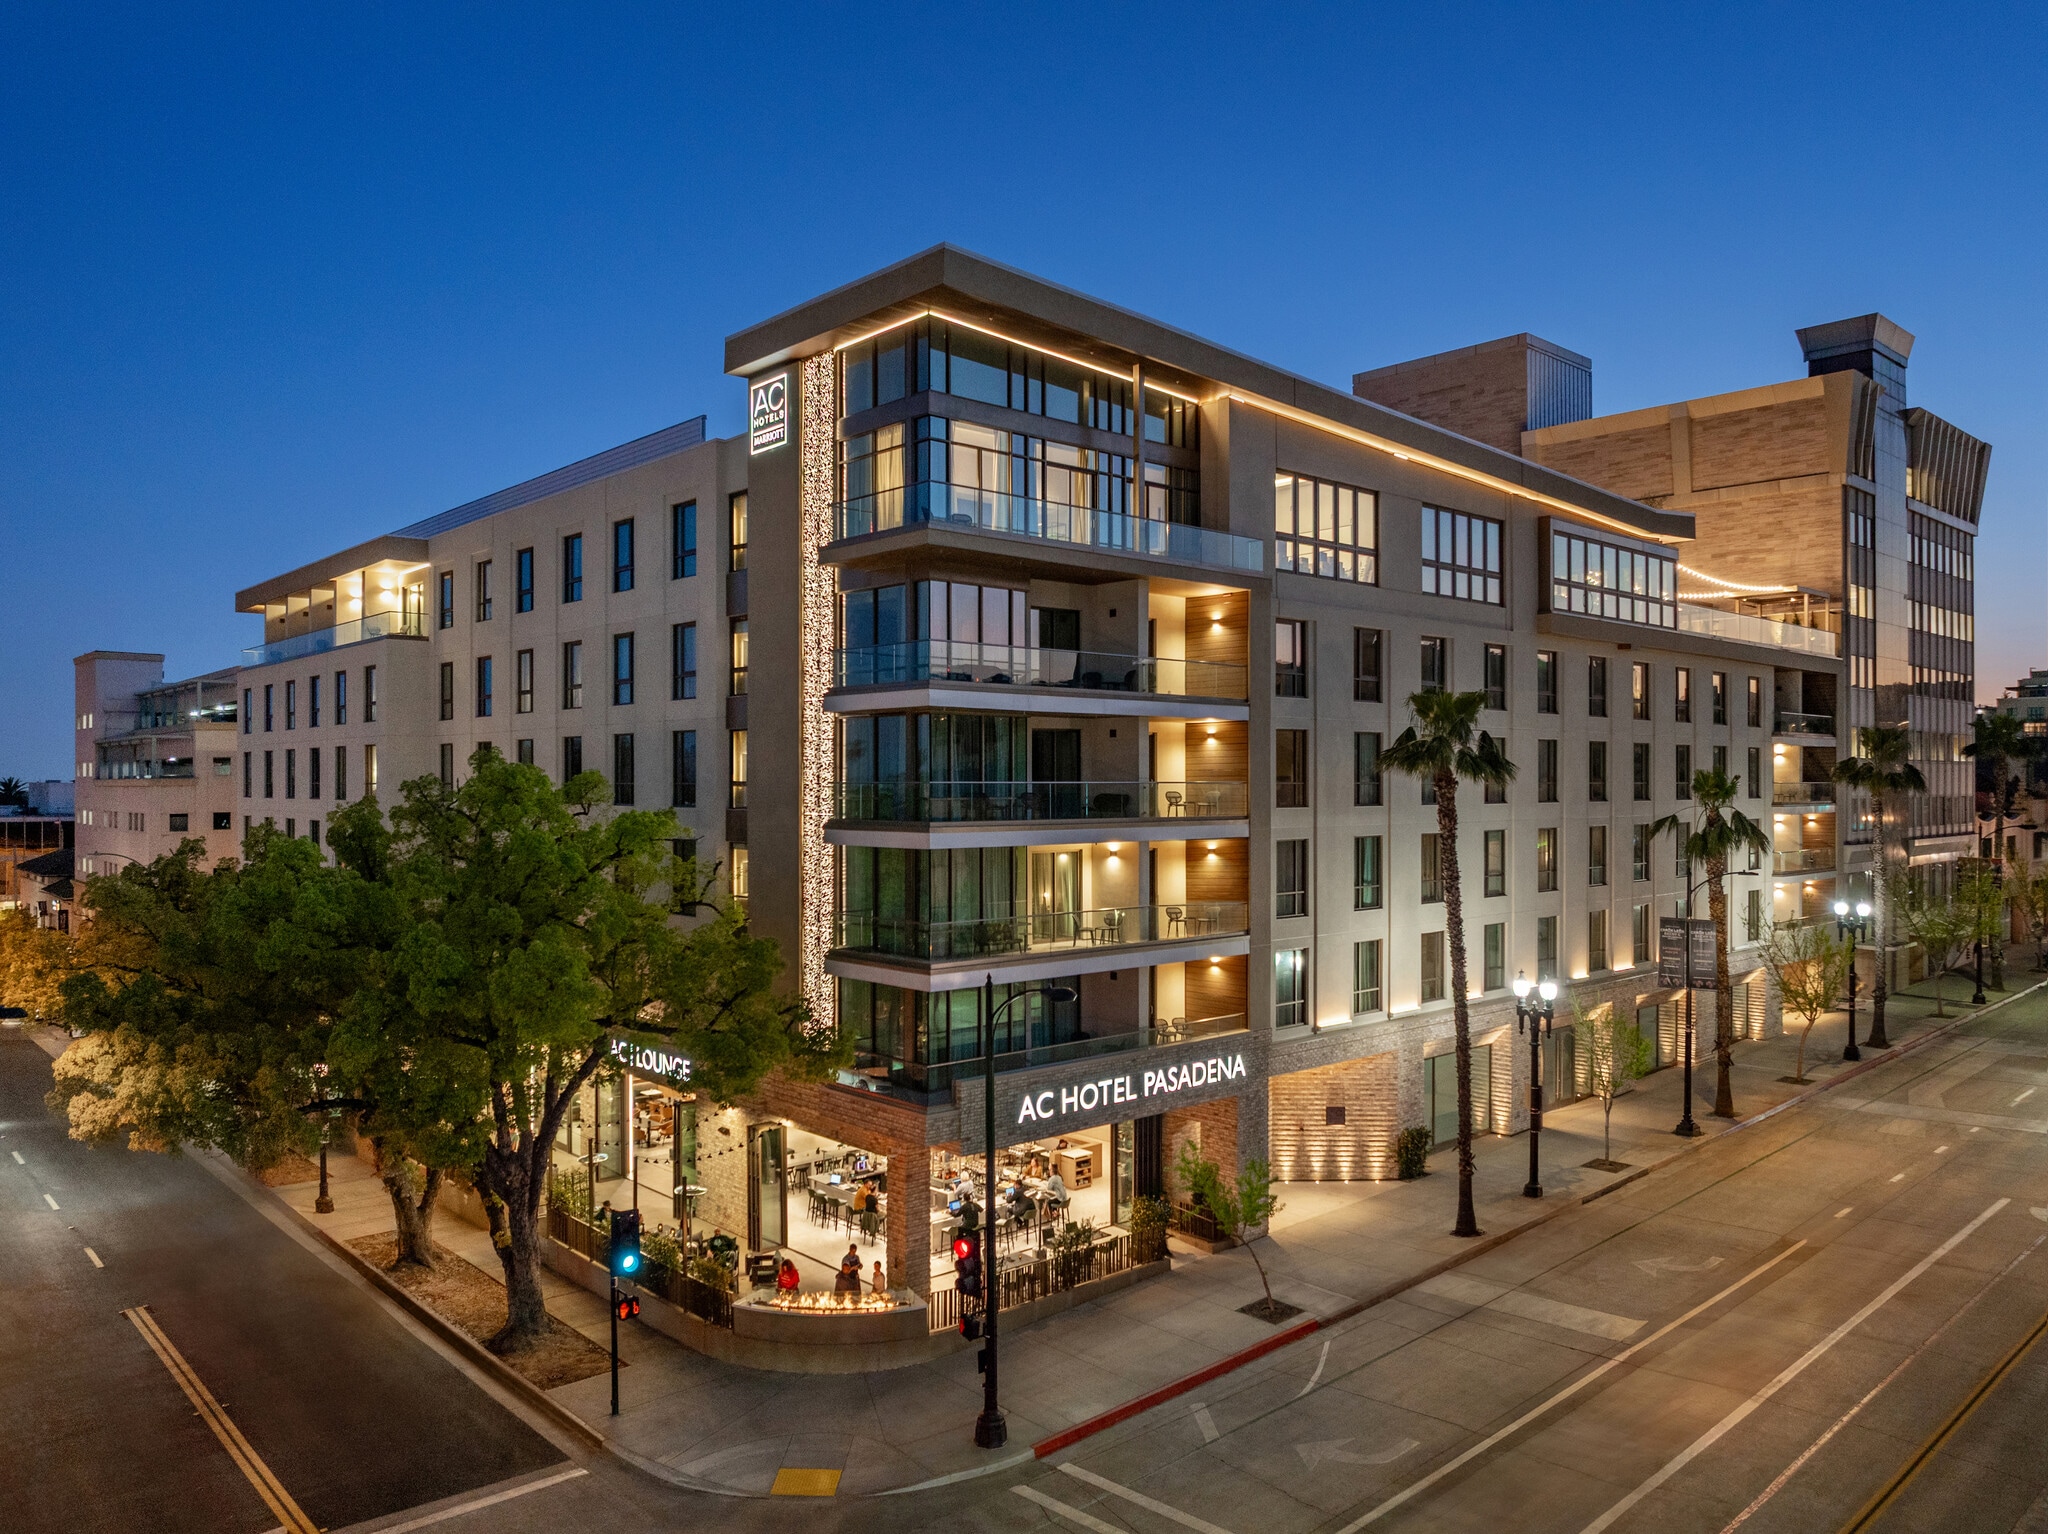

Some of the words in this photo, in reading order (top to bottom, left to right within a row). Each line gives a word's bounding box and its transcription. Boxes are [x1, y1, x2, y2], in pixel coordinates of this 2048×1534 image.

[754, 382, 784, 418] AC
[754, 410, 784, 428] HOTELS
[754, 429, 784, 446] MARRIOTT
[636, 1046, 691, 1082] LOUNGE
[1018, 1091, 1054, 1124] AC
[1061, 1075, 1138, 1115] HOTEL
[1143, 1054, 1247, 1097] PASADENA
